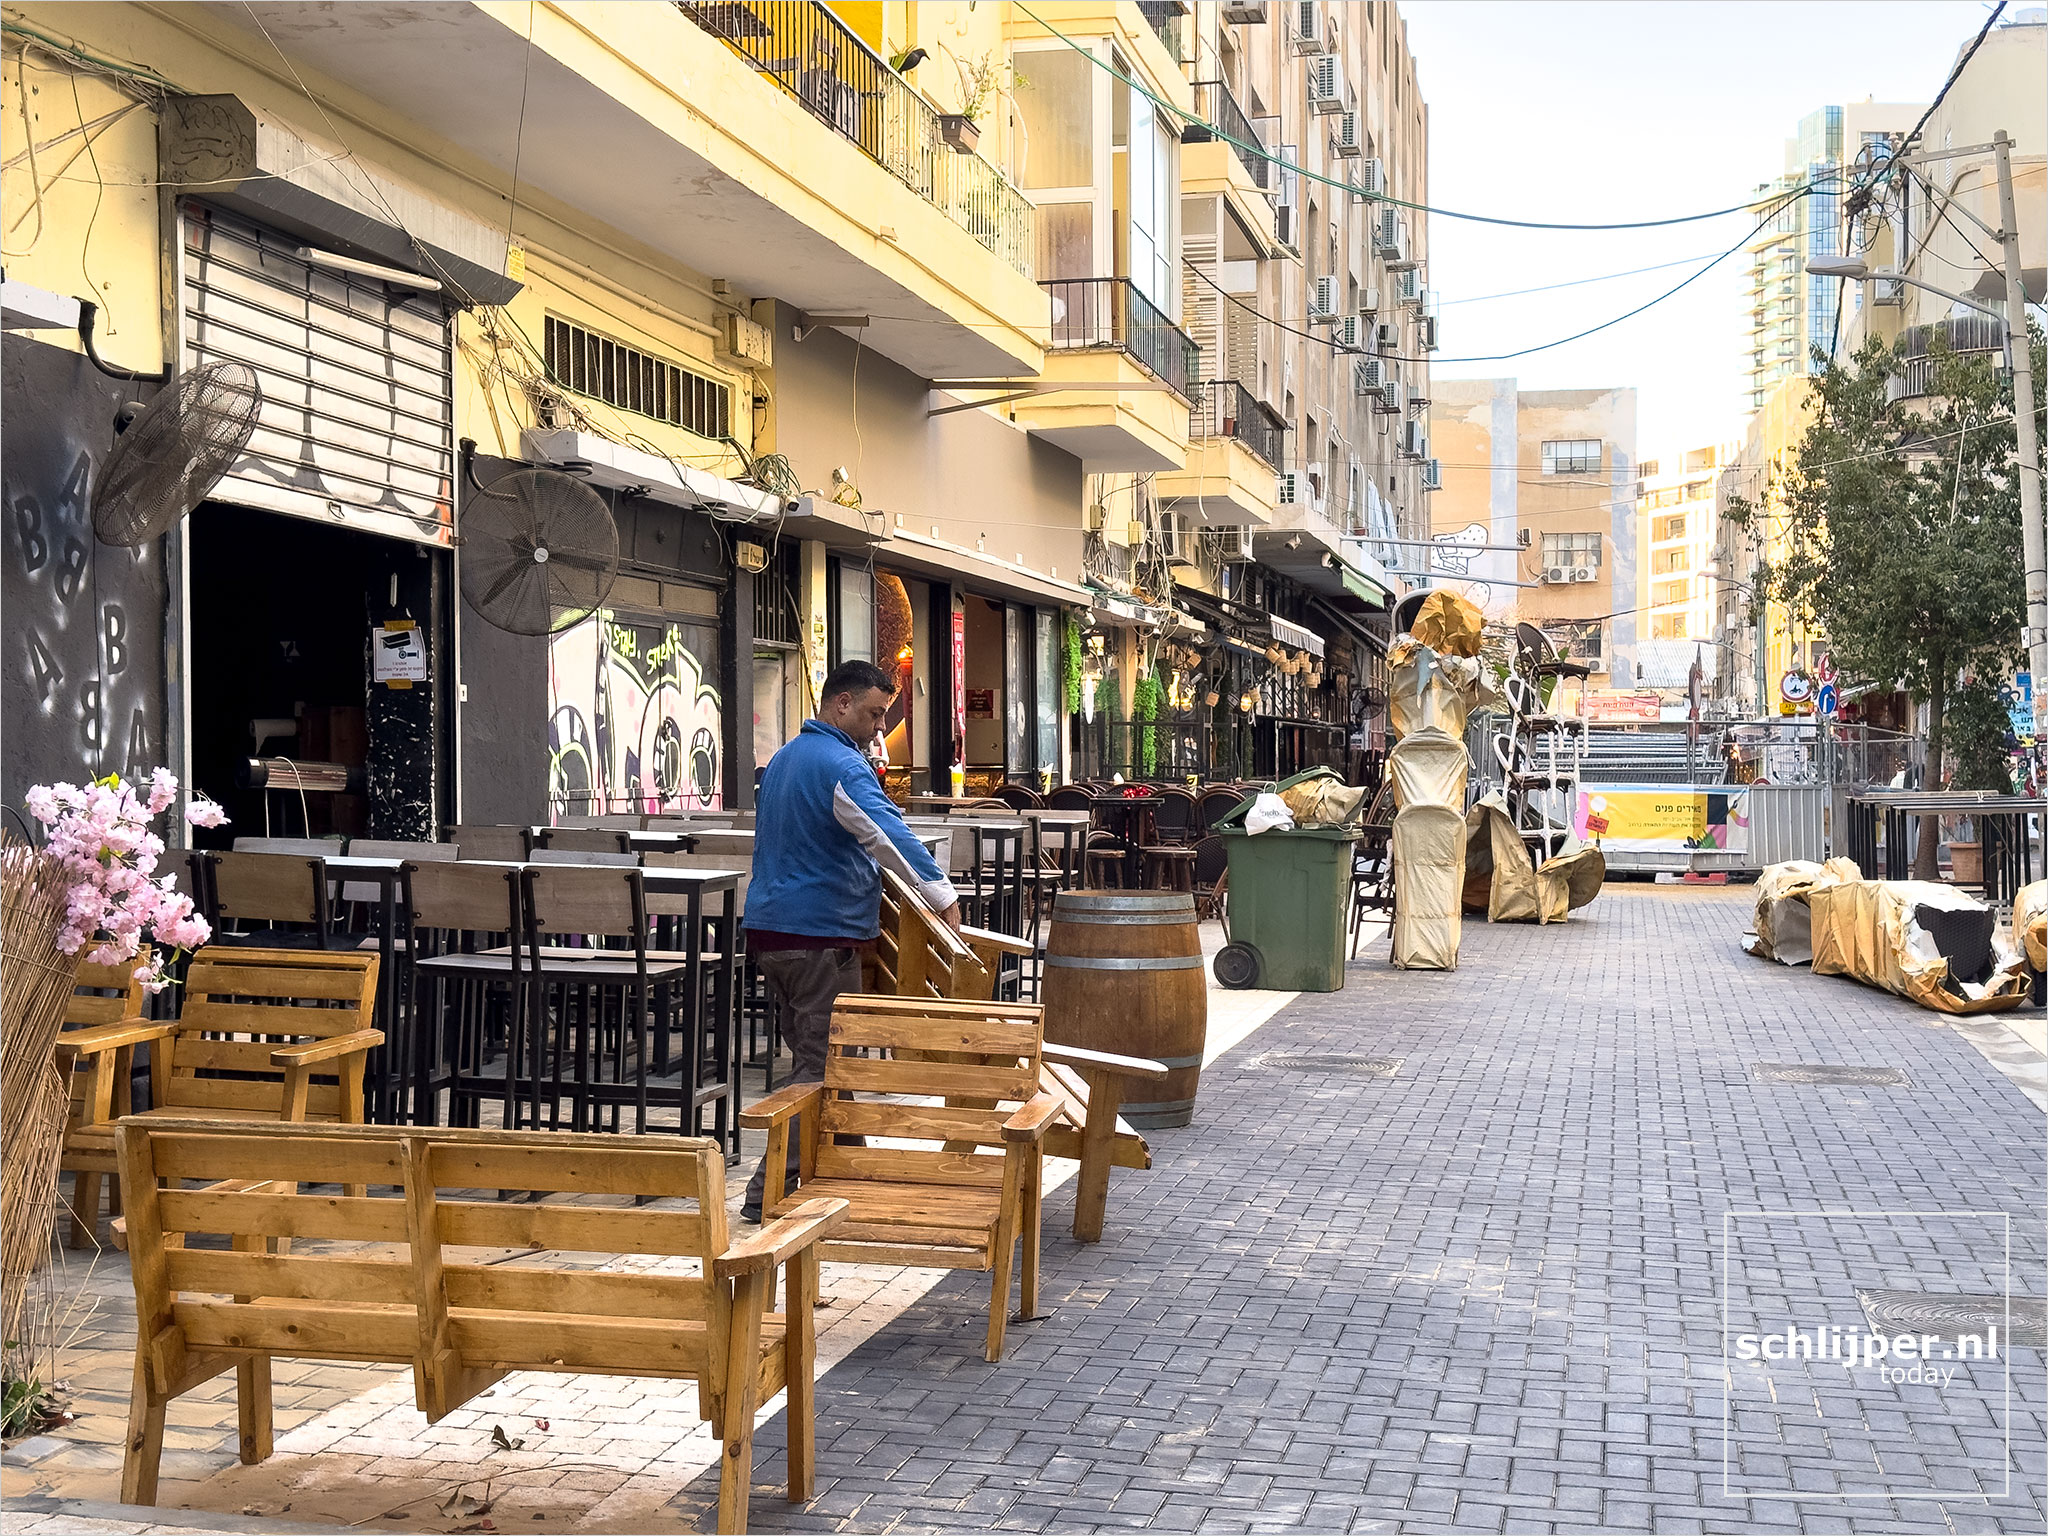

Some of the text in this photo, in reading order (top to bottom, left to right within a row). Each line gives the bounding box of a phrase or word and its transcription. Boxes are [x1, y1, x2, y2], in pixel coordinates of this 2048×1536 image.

[14, 495, 47, 573] B
[25, 622, 63, 703] A
[103, 603, 128, 675] B
[125, 708, 151, 779] A
[1655, 805, 1673, 813] פנים
